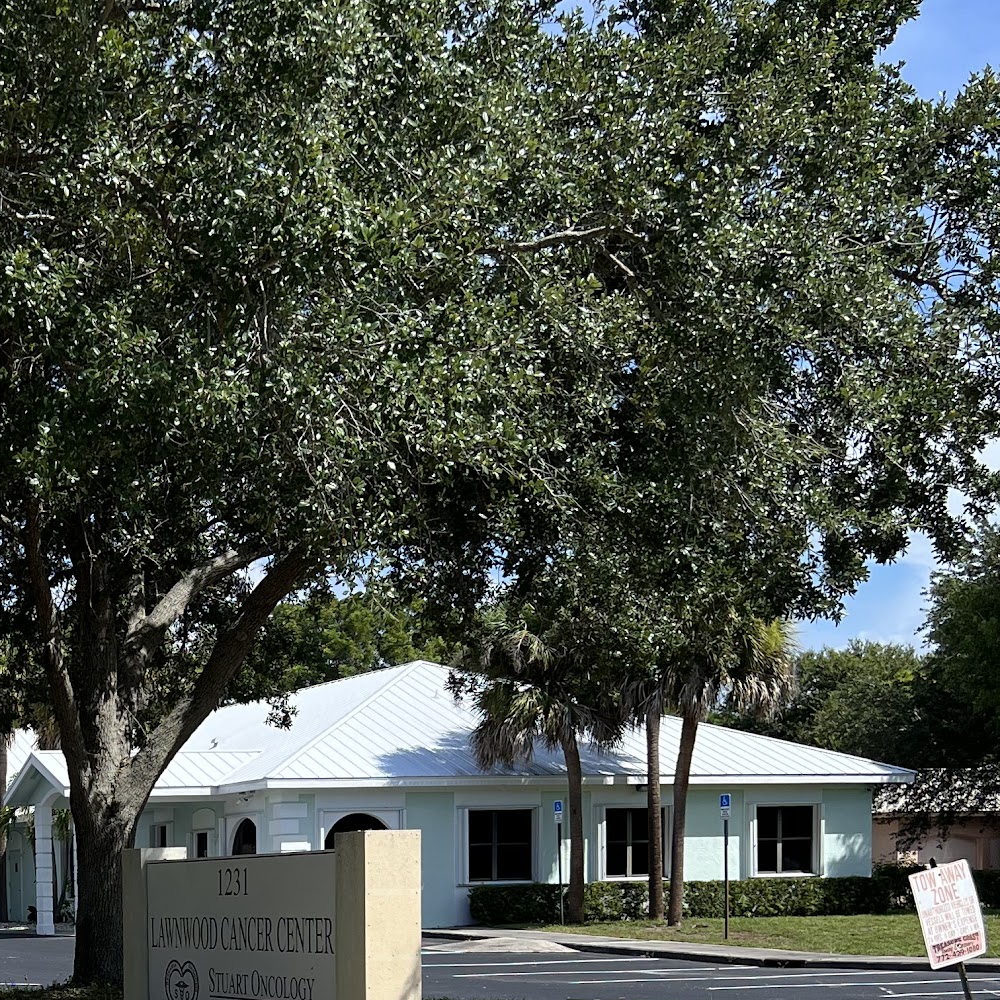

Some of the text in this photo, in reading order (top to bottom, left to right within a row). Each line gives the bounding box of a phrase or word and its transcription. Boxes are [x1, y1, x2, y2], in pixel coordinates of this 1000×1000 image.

[218, 867, 249, 896] 1231
[913, 862, 967, 893] TOW AWAY
[931, 882, 960, 905] ZONE
[151, 916, 335, 955] LAWNWOOD CANCER CENTER
[208, 967, 249, 995] STUART
[251, 969, 315, 1000] ONCOLOGY
